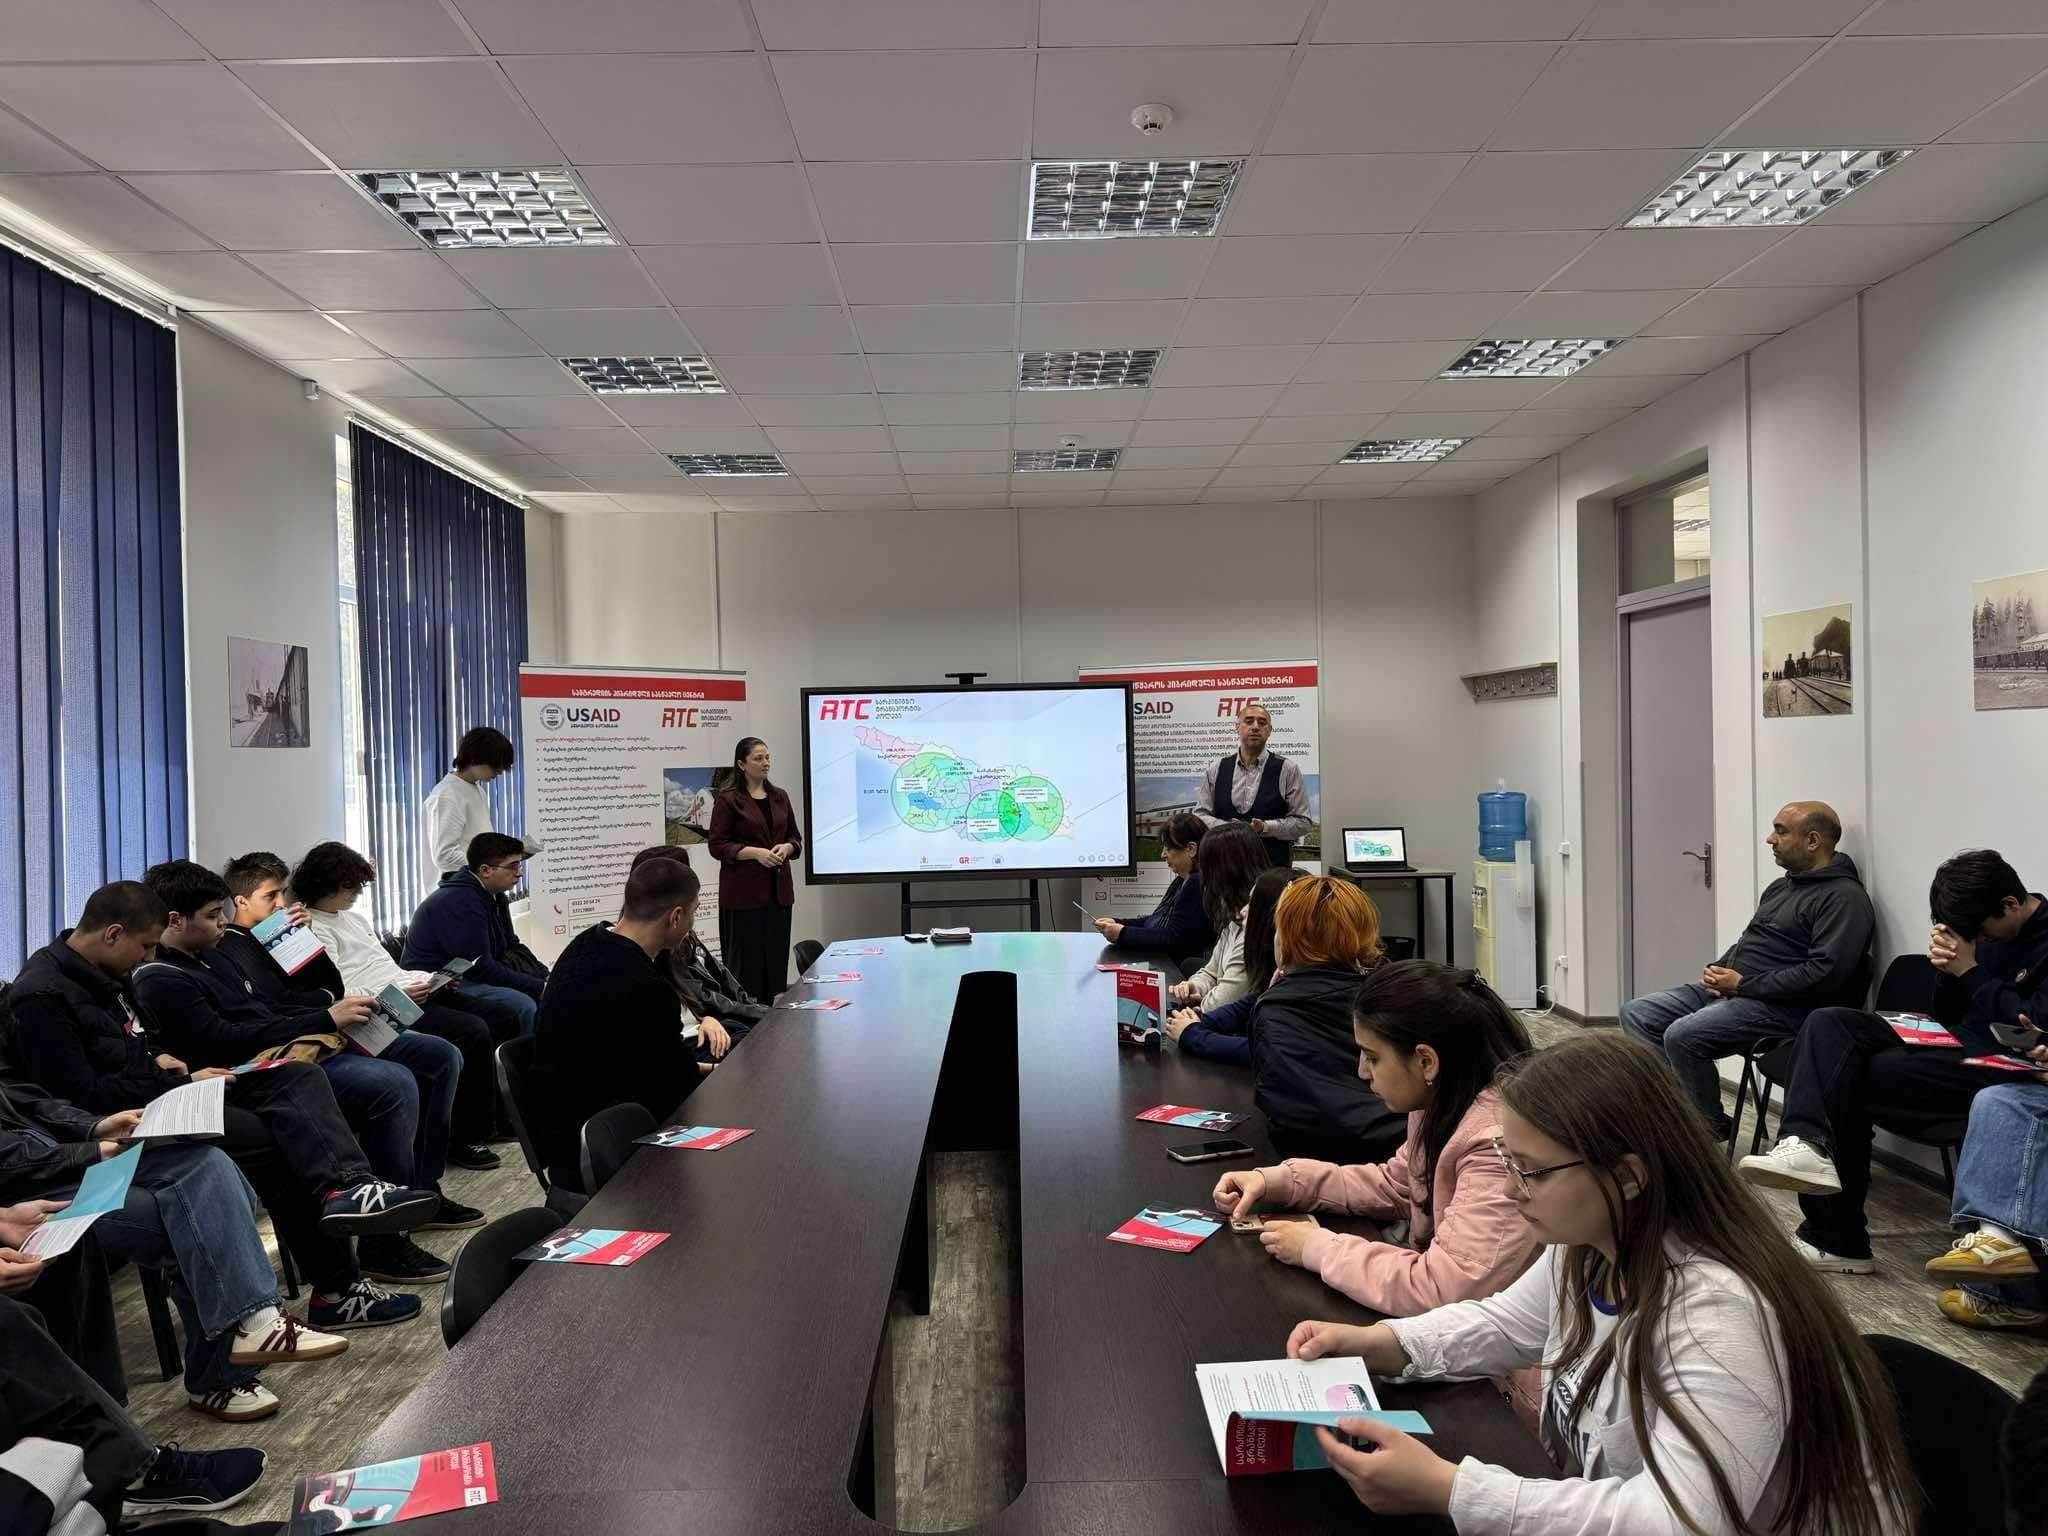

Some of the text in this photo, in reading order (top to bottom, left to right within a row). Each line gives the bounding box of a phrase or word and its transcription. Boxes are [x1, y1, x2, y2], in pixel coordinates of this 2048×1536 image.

[1167, 679, 1216, 690] ჰიბრიდული
[1217, 677, 1260, 687] სასწავლო
[1261, 676, 1294, 686] ცენტრი
[566, 708, 620, 722] USAID
[820, 699, 872, 720] RTC
[1134, 701, 1174, 714] SAID
[662, 708, 699, 728] RTC
[1236, 1420, 1246, 1465] სარკინიგ
